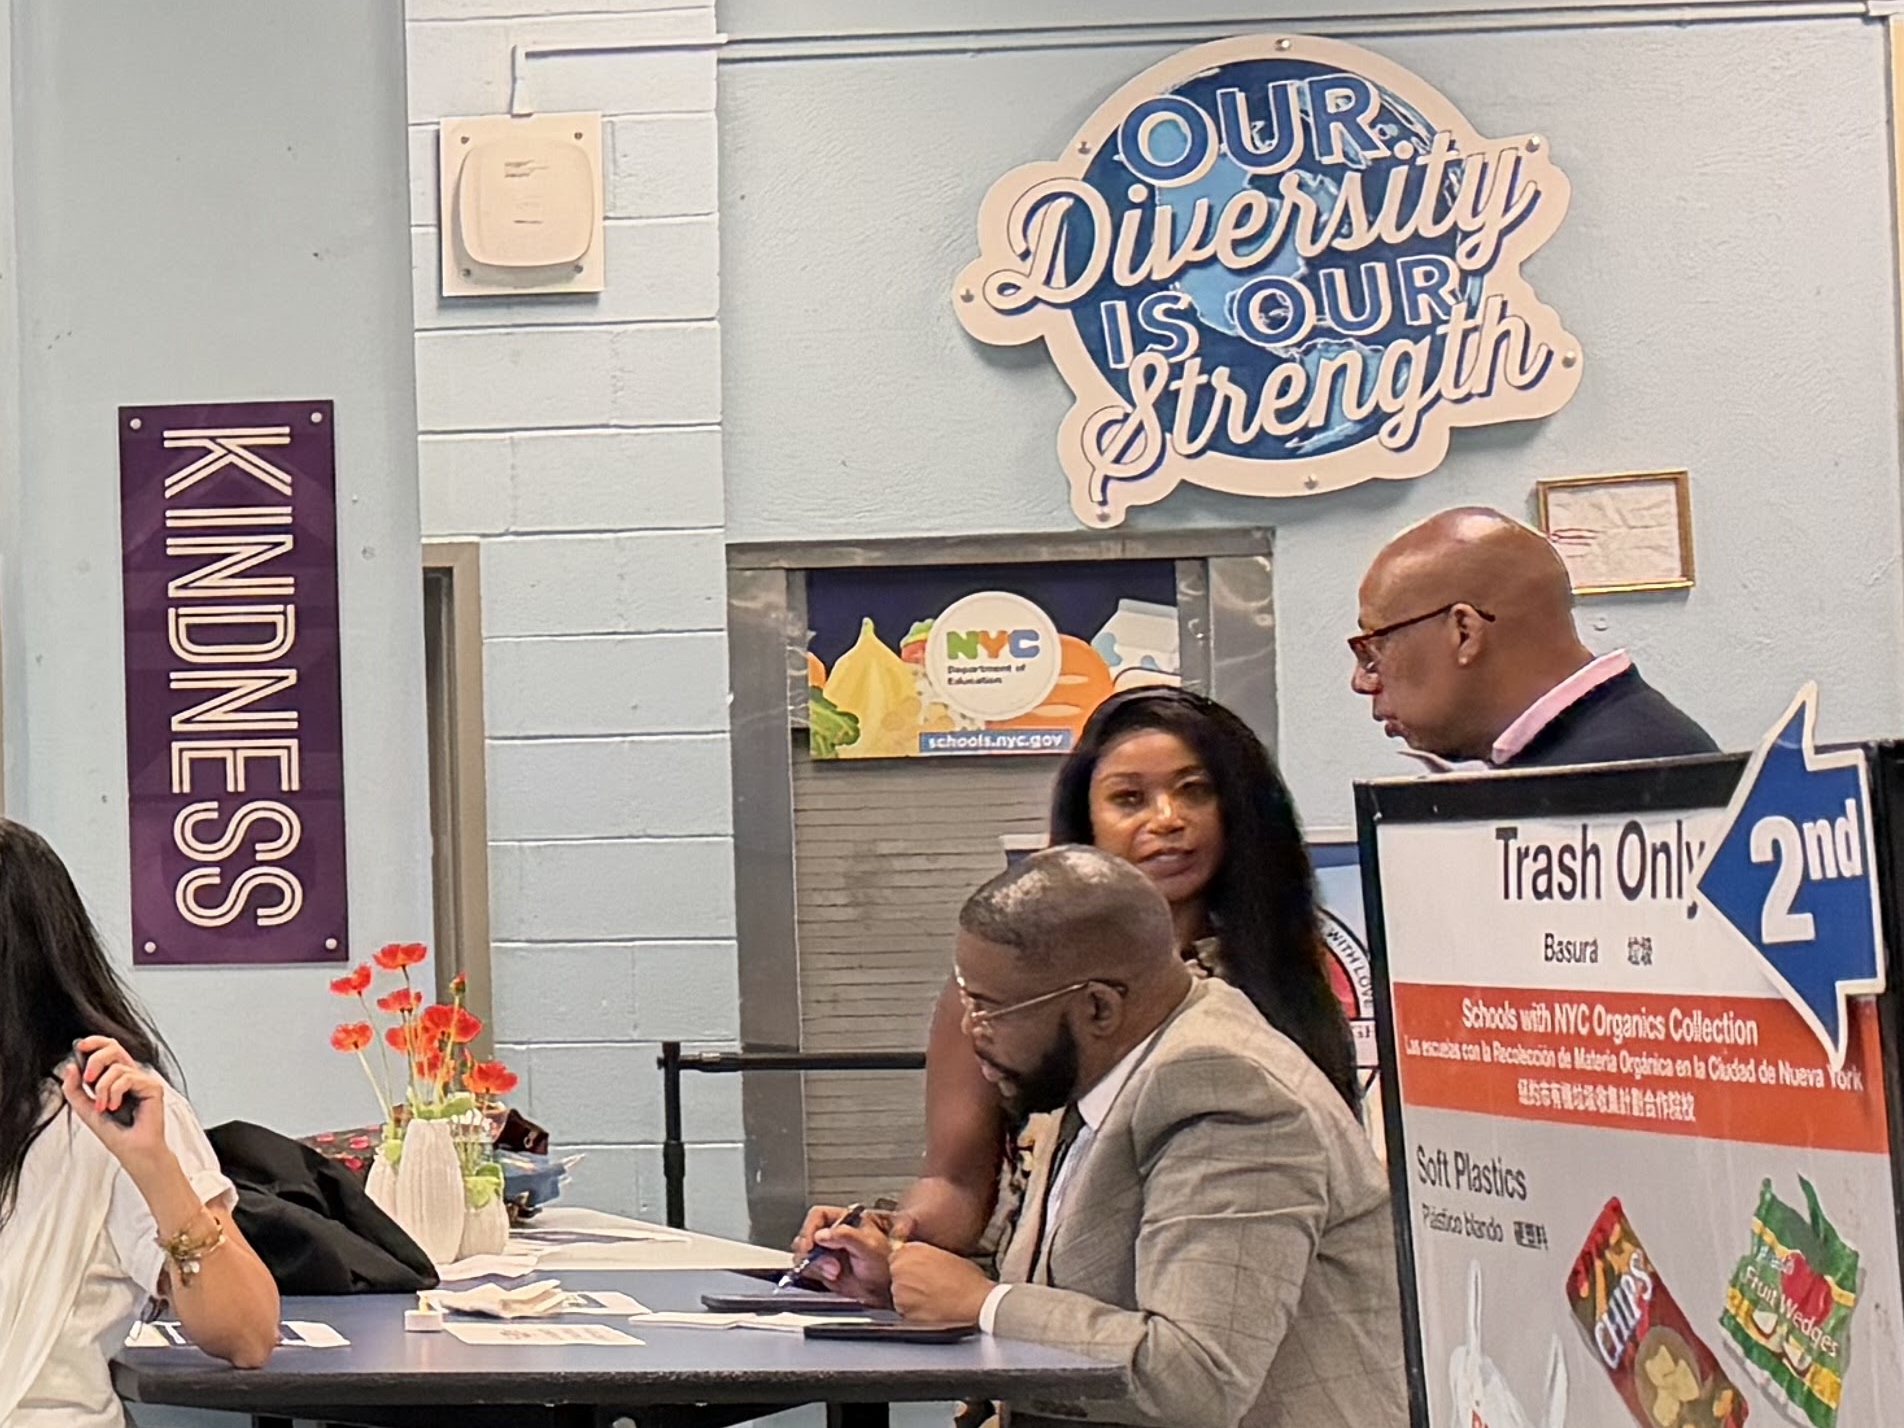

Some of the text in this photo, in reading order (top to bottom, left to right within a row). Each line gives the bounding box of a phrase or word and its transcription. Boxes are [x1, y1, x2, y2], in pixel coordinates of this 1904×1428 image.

[1119, 75, 1389, 185] OUR
[985, 130, 1540, 315] Diversity
[1100, 255, 1465, 371] IS OUR
[1085, 293, 1554, 505] Strength
[162, 424, 304, 928] KINDNESS
[946, 629, 1041, 660] NYC
[947, 663, 1027, 674] Department of
[947, 677, 1003, 685] Education
[927, 732, 1064, 750] schools.nyc.gov
[1495, 819, 1706, 919] Trash Only
[1749, 797, 1864, 944] 2nd
[1543, 933, 1598, 963] Basura
[1462, 998, 1759, 1046] Schools with NYC Organics Collection
[1574, 1047, 1617, 1072] Materia
[1758, 1063, 1776, 1085] de
[1778, 1060, 1825, 1089] Nueva
[1416, 1144, 1528, 1201] Soft Plastics
[1594, 1247, 1653, 1370] CHIPS
[1741, 1265, 1840, 1358] Fruit Wedges
